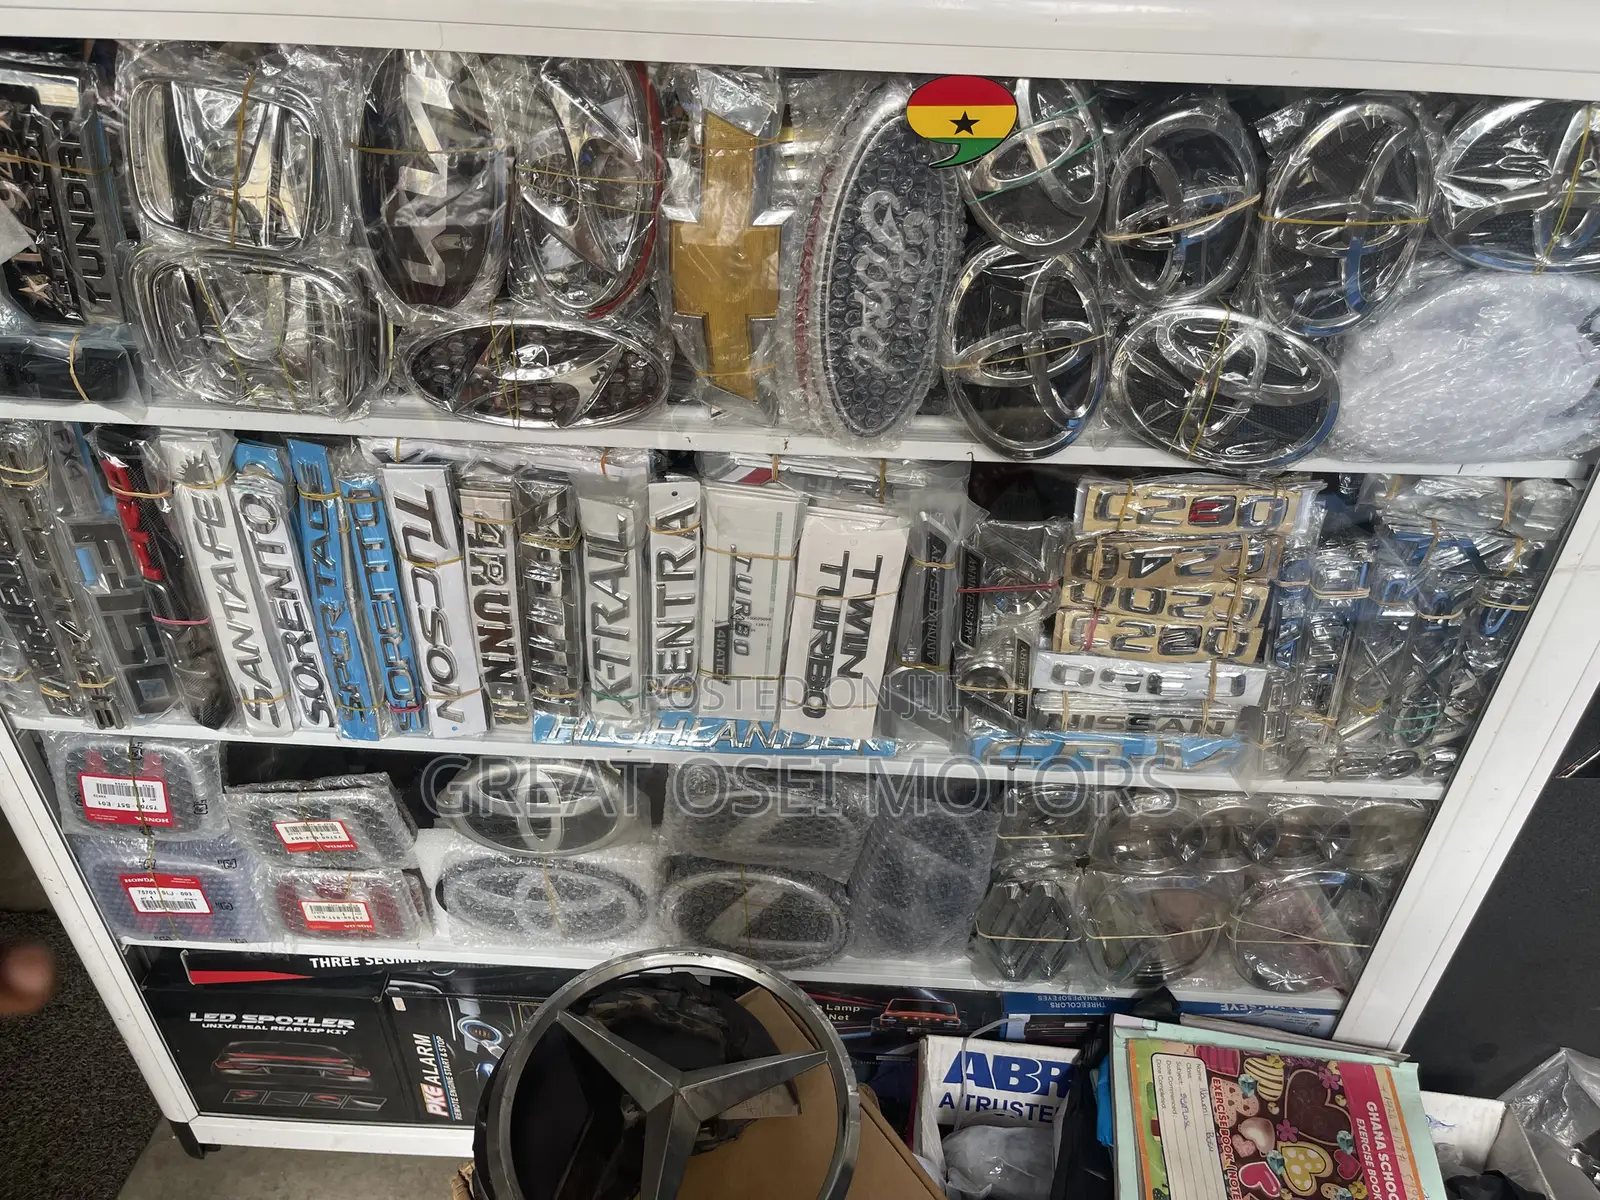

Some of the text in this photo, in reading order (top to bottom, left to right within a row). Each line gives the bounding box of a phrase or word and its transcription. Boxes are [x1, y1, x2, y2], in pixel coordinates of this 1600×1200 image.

[239, 492, 335, 728] SORENTO
[301, 463, 367, 724] SPORTAGE
[351, 488, 424, 732] SORENTO
[393, 484, 466, 723] TUCSON
[467, 511, 530, 725] 4RUNNER
[585, 512, 635, 716] X-TRAIL
[733, 552, 752, 656] TURBO
[837, 554, 883, 679] TWIN
[926, 544, 943, 664] ANNIVERSARY
[964, 559, 979, 646] ANNIVERSARY
[802, 551, 849, 719] TURBO
[1047, 713, 1225, 734] NISSAN
[309, 957, 360, 968] THREE
[189, 1012, 356, 1030] LED SPOILER
[202, 1023, 268, 1031] UNIVERSAL
[270, 1025, 301, 1033] REAR
[826, 1004, 861, 1013] Lamp
[413, 1033, 450, 1117] PKE ALARM
[436, 1035, 447, 1052] STOP
[441, 1056, 453, 1076] START
[445, 1076, 458, 1097] ENGINE
[450, 1096, 463, 1121] REMOTE
[938, 1092, 1070, 1123] A TRUSTE
[1212, 1077, 1231, 1128] EXERCISE
[1220, 1129, 1235, 1162] BOOK
[1355, 1117, 1384, 1200] EXERCISE BOOK
[1366, 1101, 1387, 1150] GHANA
